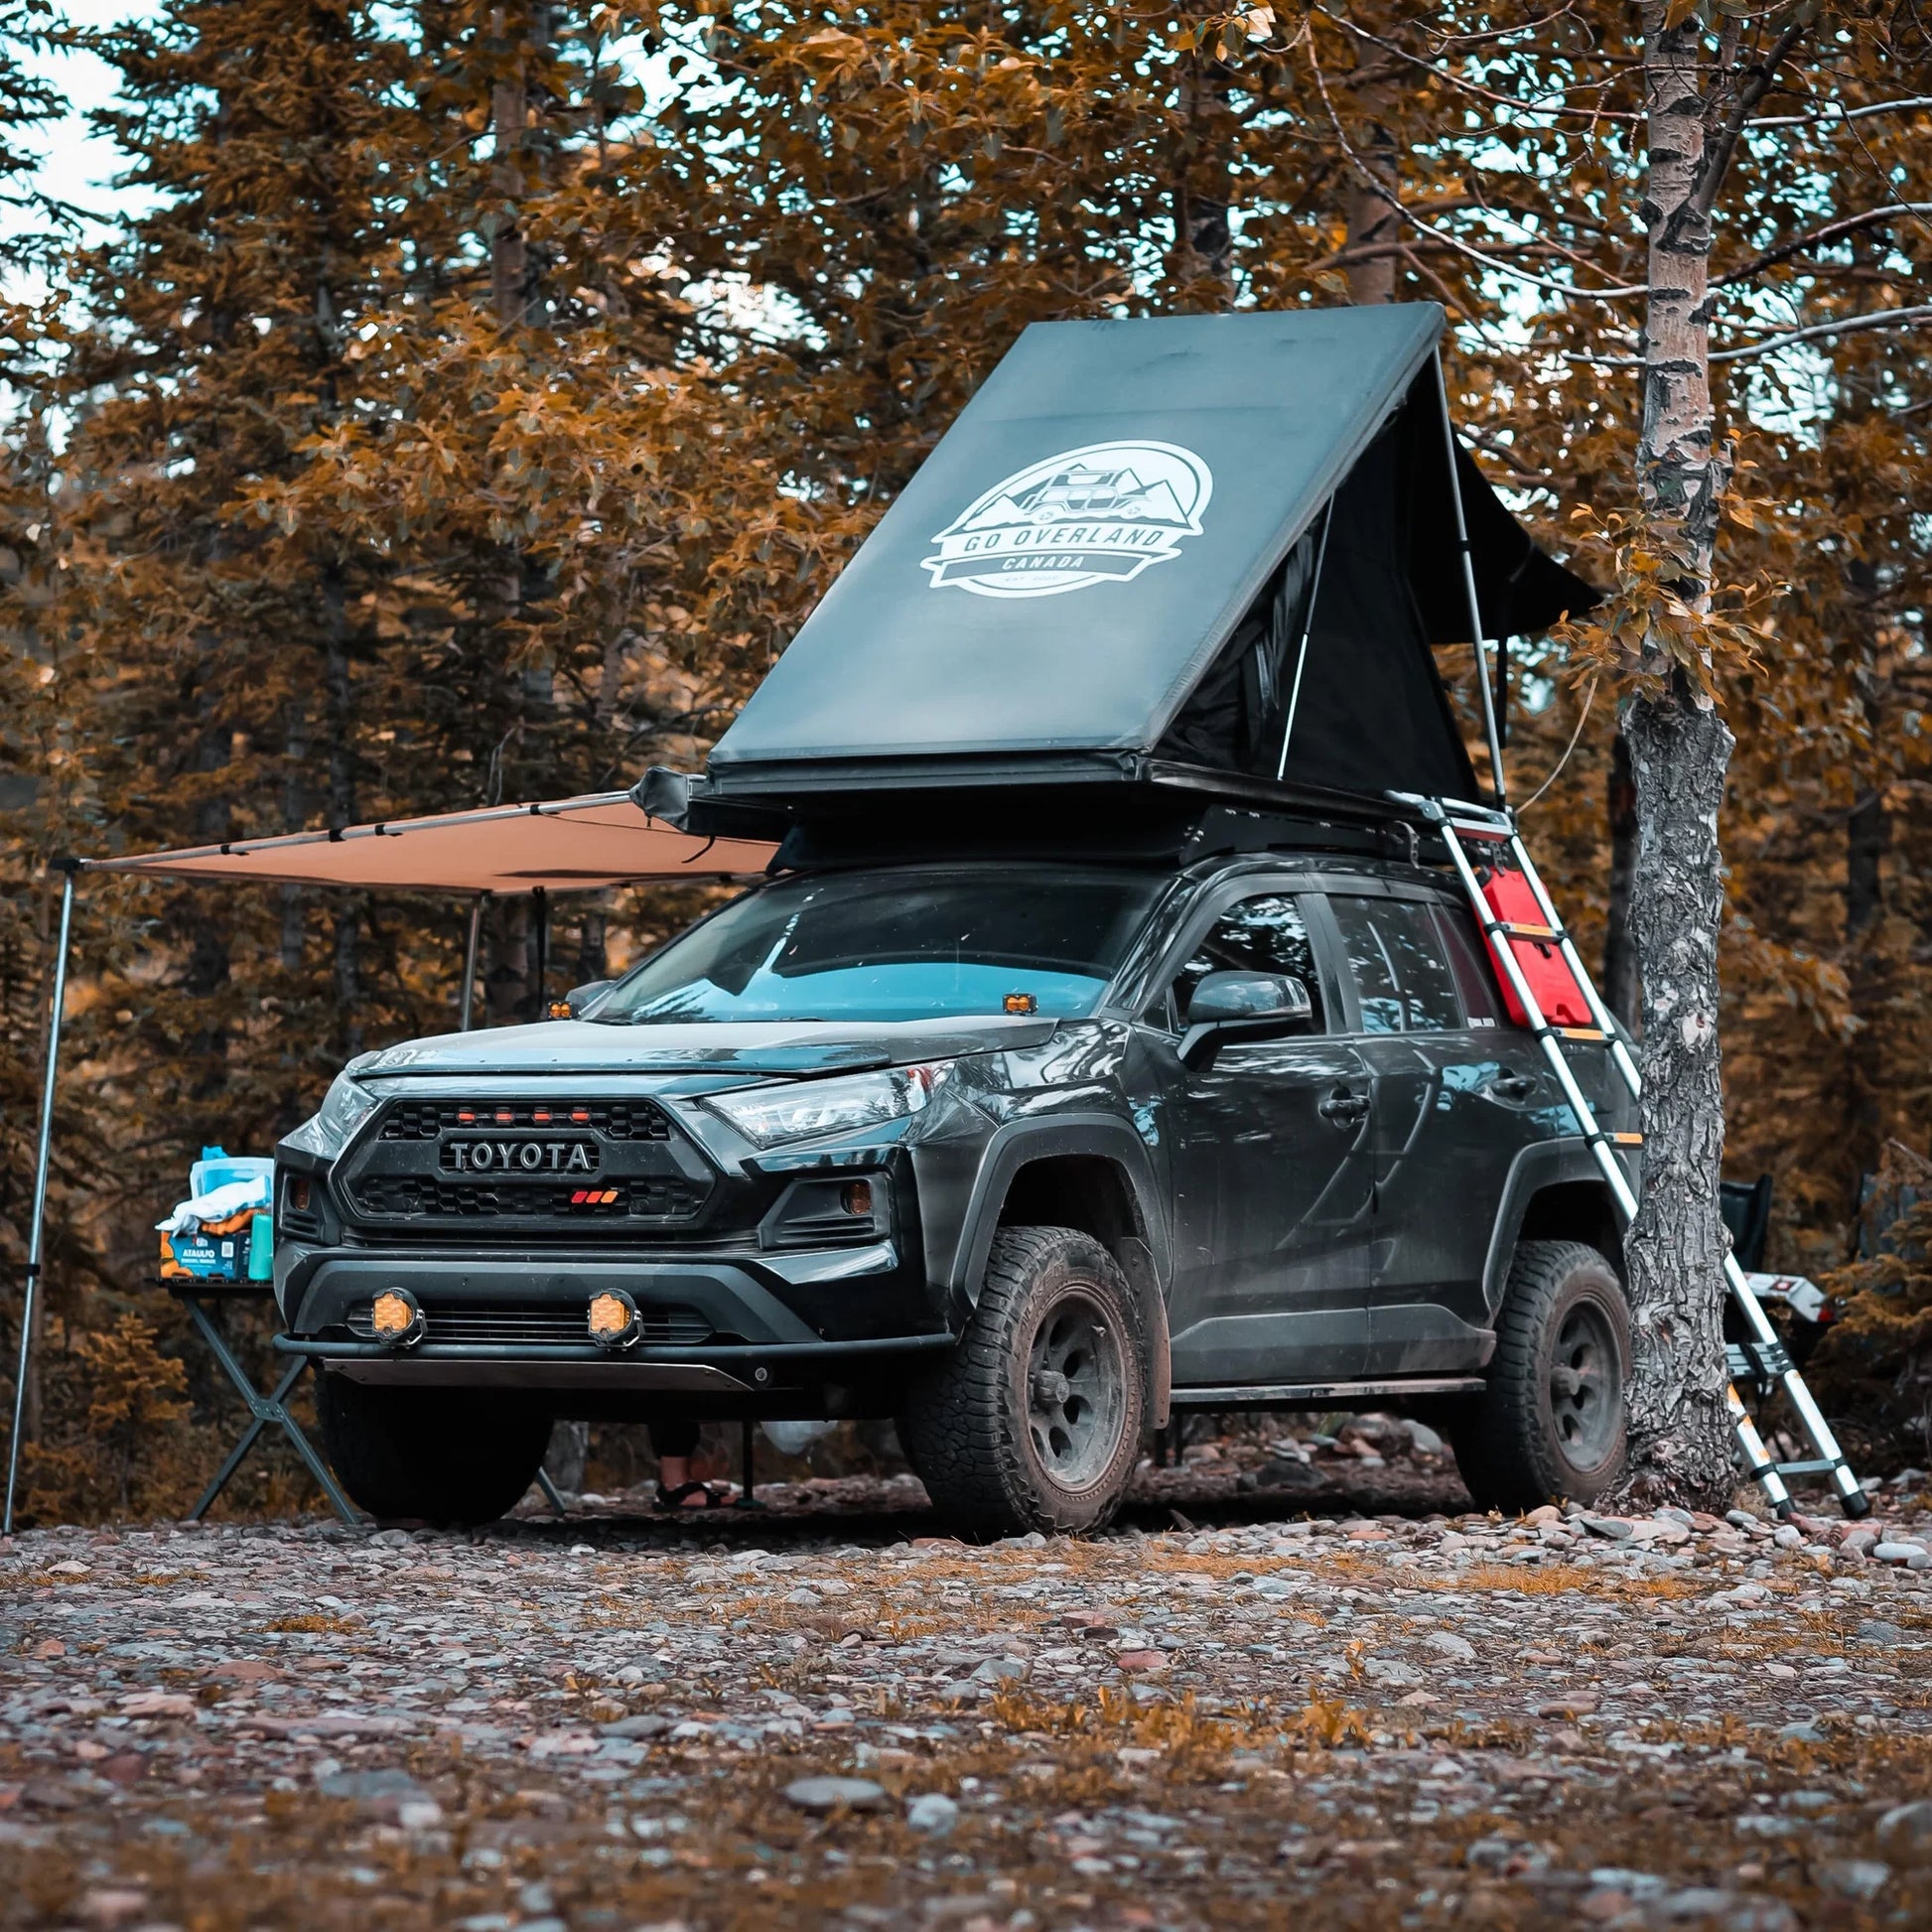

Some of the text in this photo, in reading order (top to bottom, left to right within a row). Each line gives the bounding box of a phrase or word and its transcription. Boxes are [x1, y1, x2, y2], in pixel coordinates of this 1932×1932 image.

[964, 527, 1165, 552] GO OVERLAND
[1002, 556, 1085, 571] CANADA
[450, 1143, 592, 1170] TOYOTA
